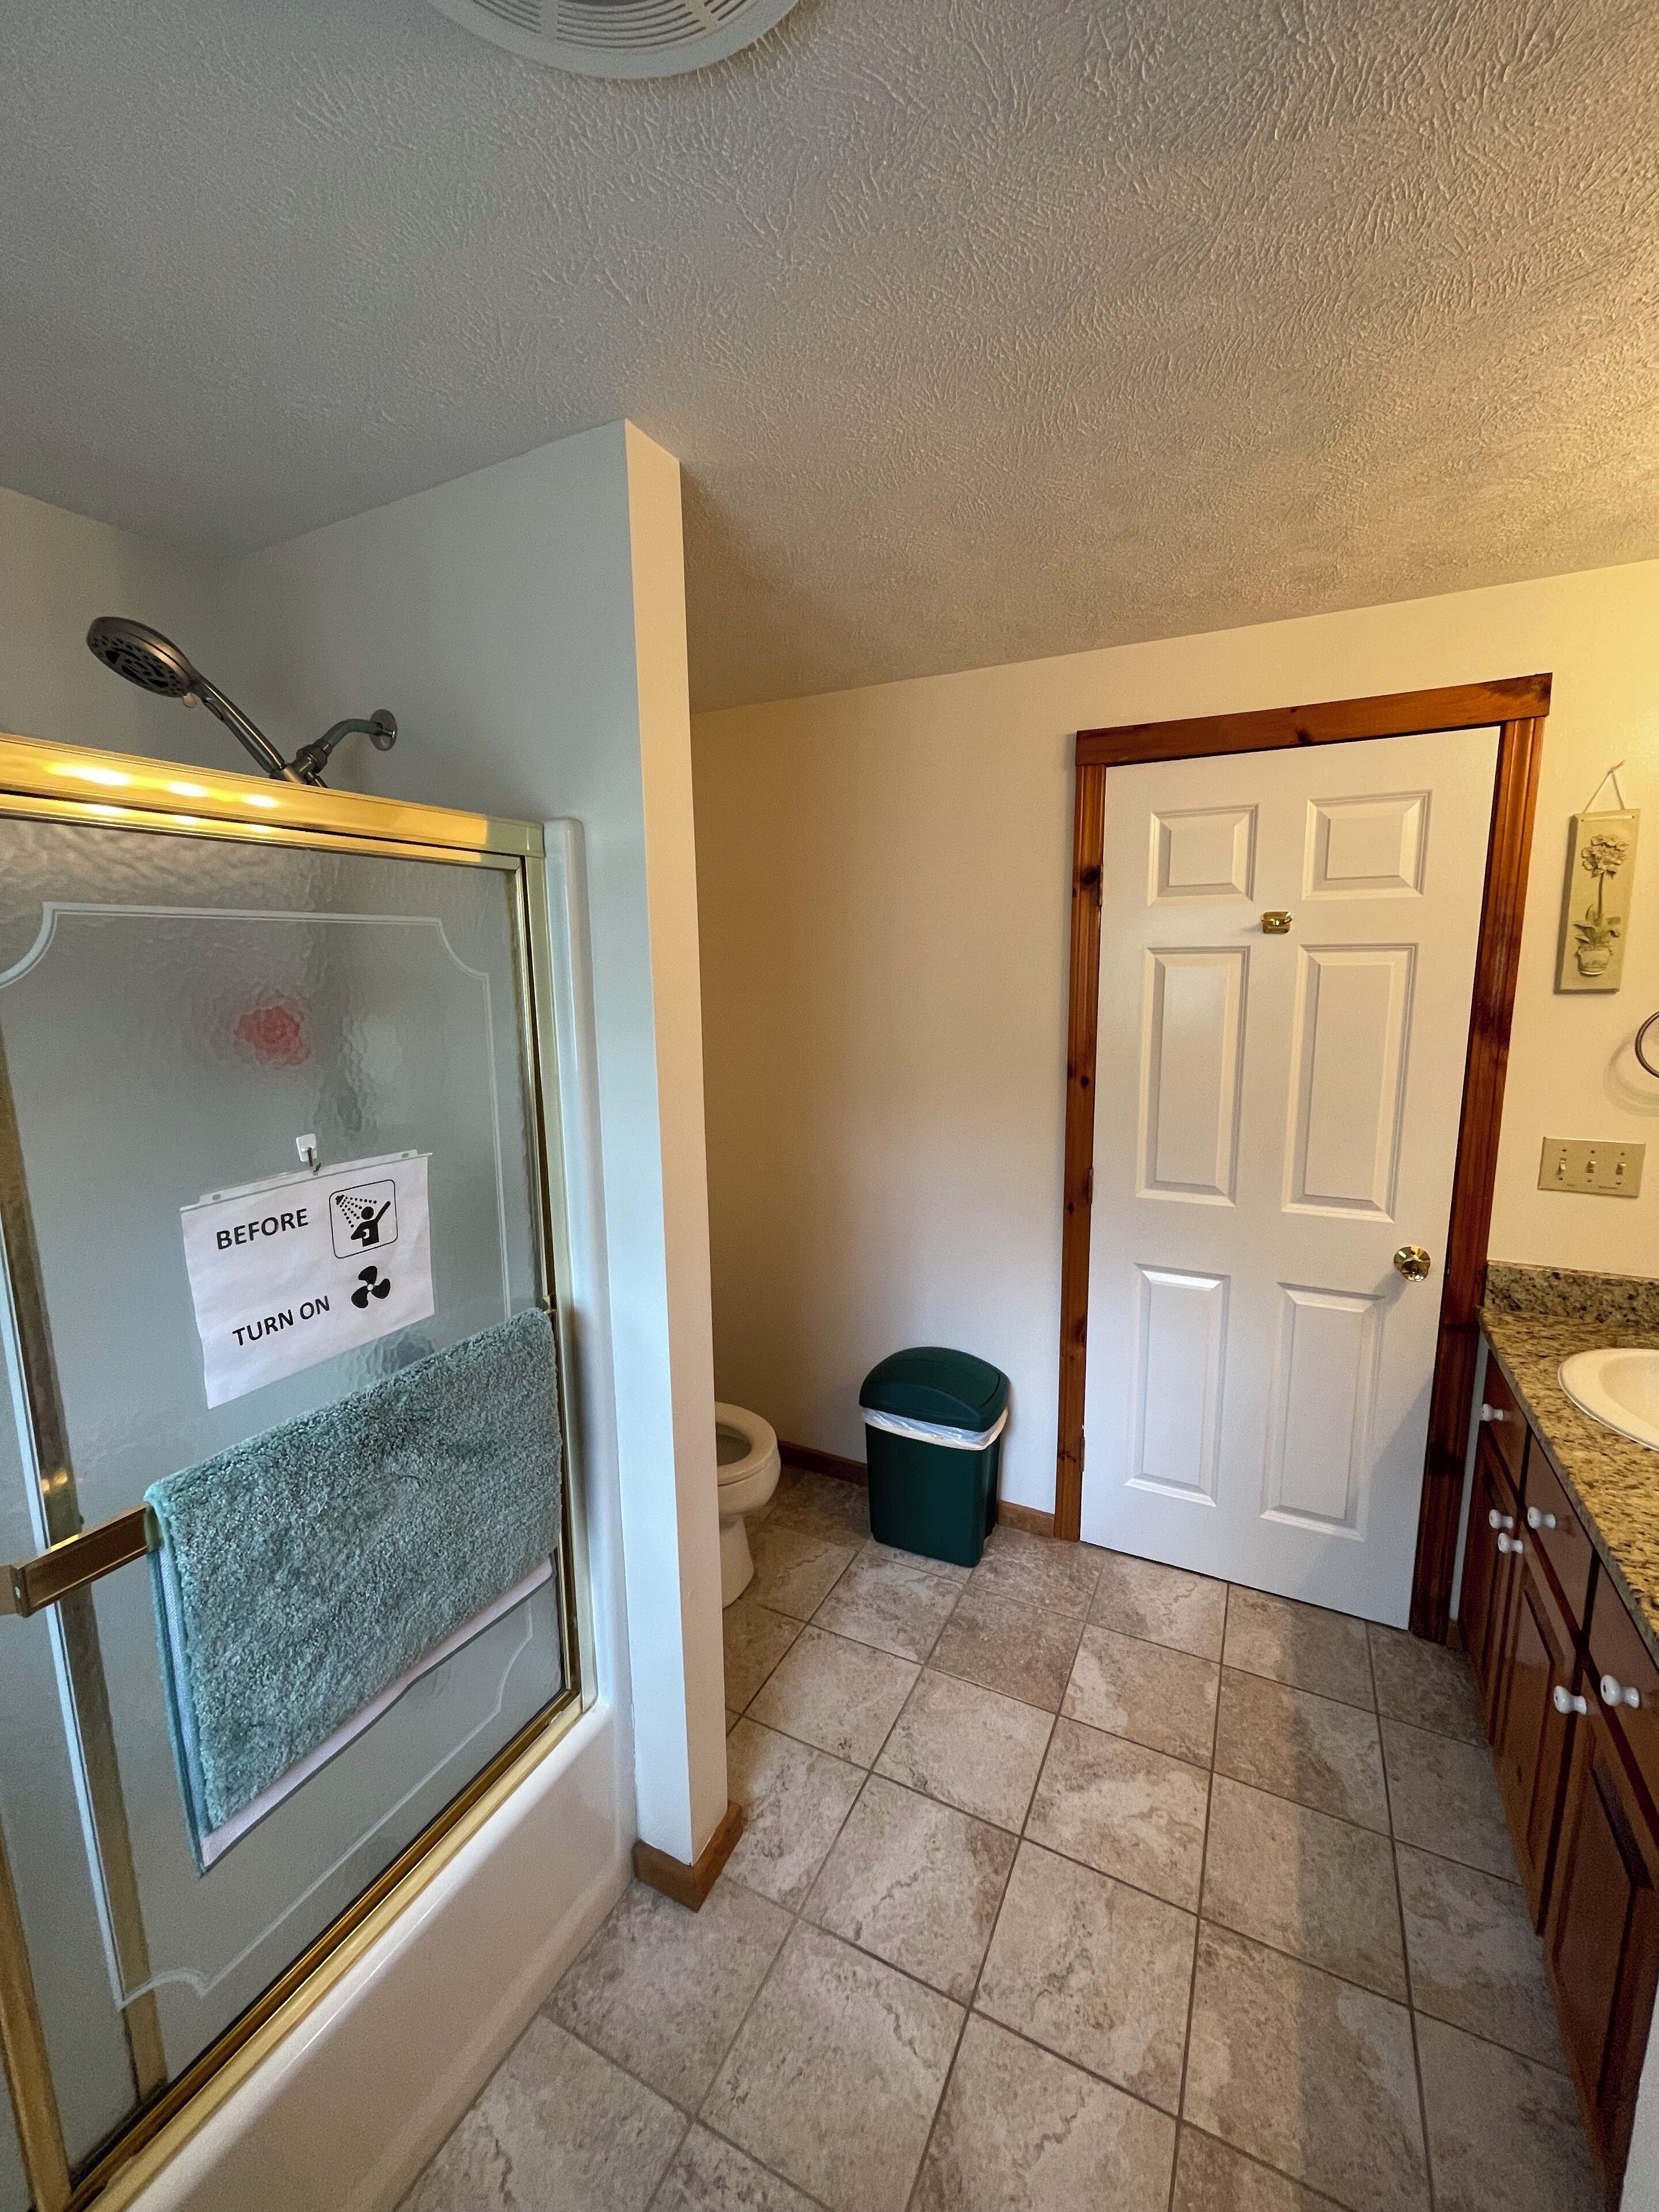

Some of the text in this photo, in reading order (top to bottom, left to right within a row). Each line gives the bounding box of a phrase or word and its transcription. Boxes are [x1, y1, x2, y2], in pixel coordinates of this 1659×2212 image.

[216, 1208, 309, 1250] BEFORE
[232, 1295, 330, 1346] TURN ON
